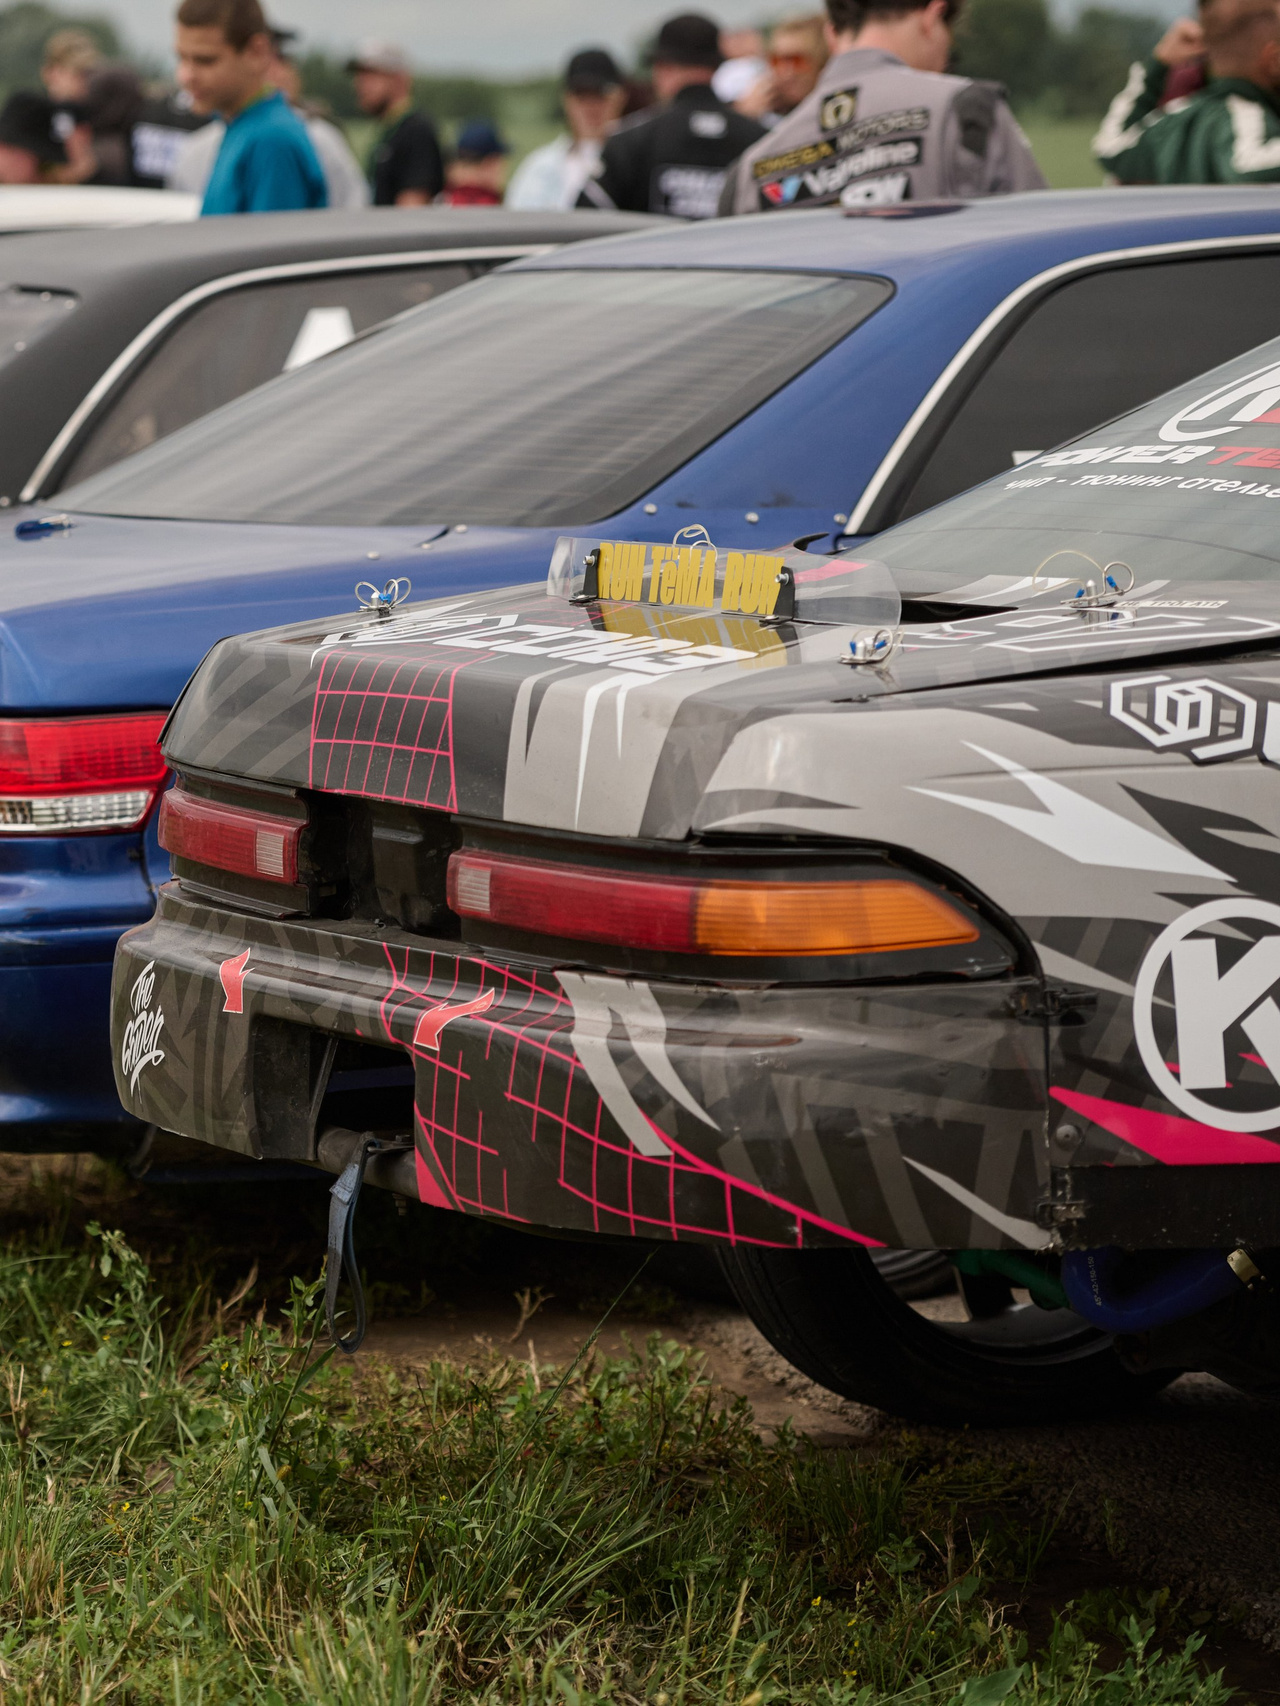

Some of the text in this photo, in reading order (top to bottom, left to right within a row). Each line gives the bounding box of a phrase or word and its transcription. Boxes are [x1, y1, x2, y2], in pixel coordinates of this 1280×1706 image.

[803, 141, 919, 196] Valvoline
[599, 542, 647, 602] RUN
[721, 551, 785, 615] RUN
